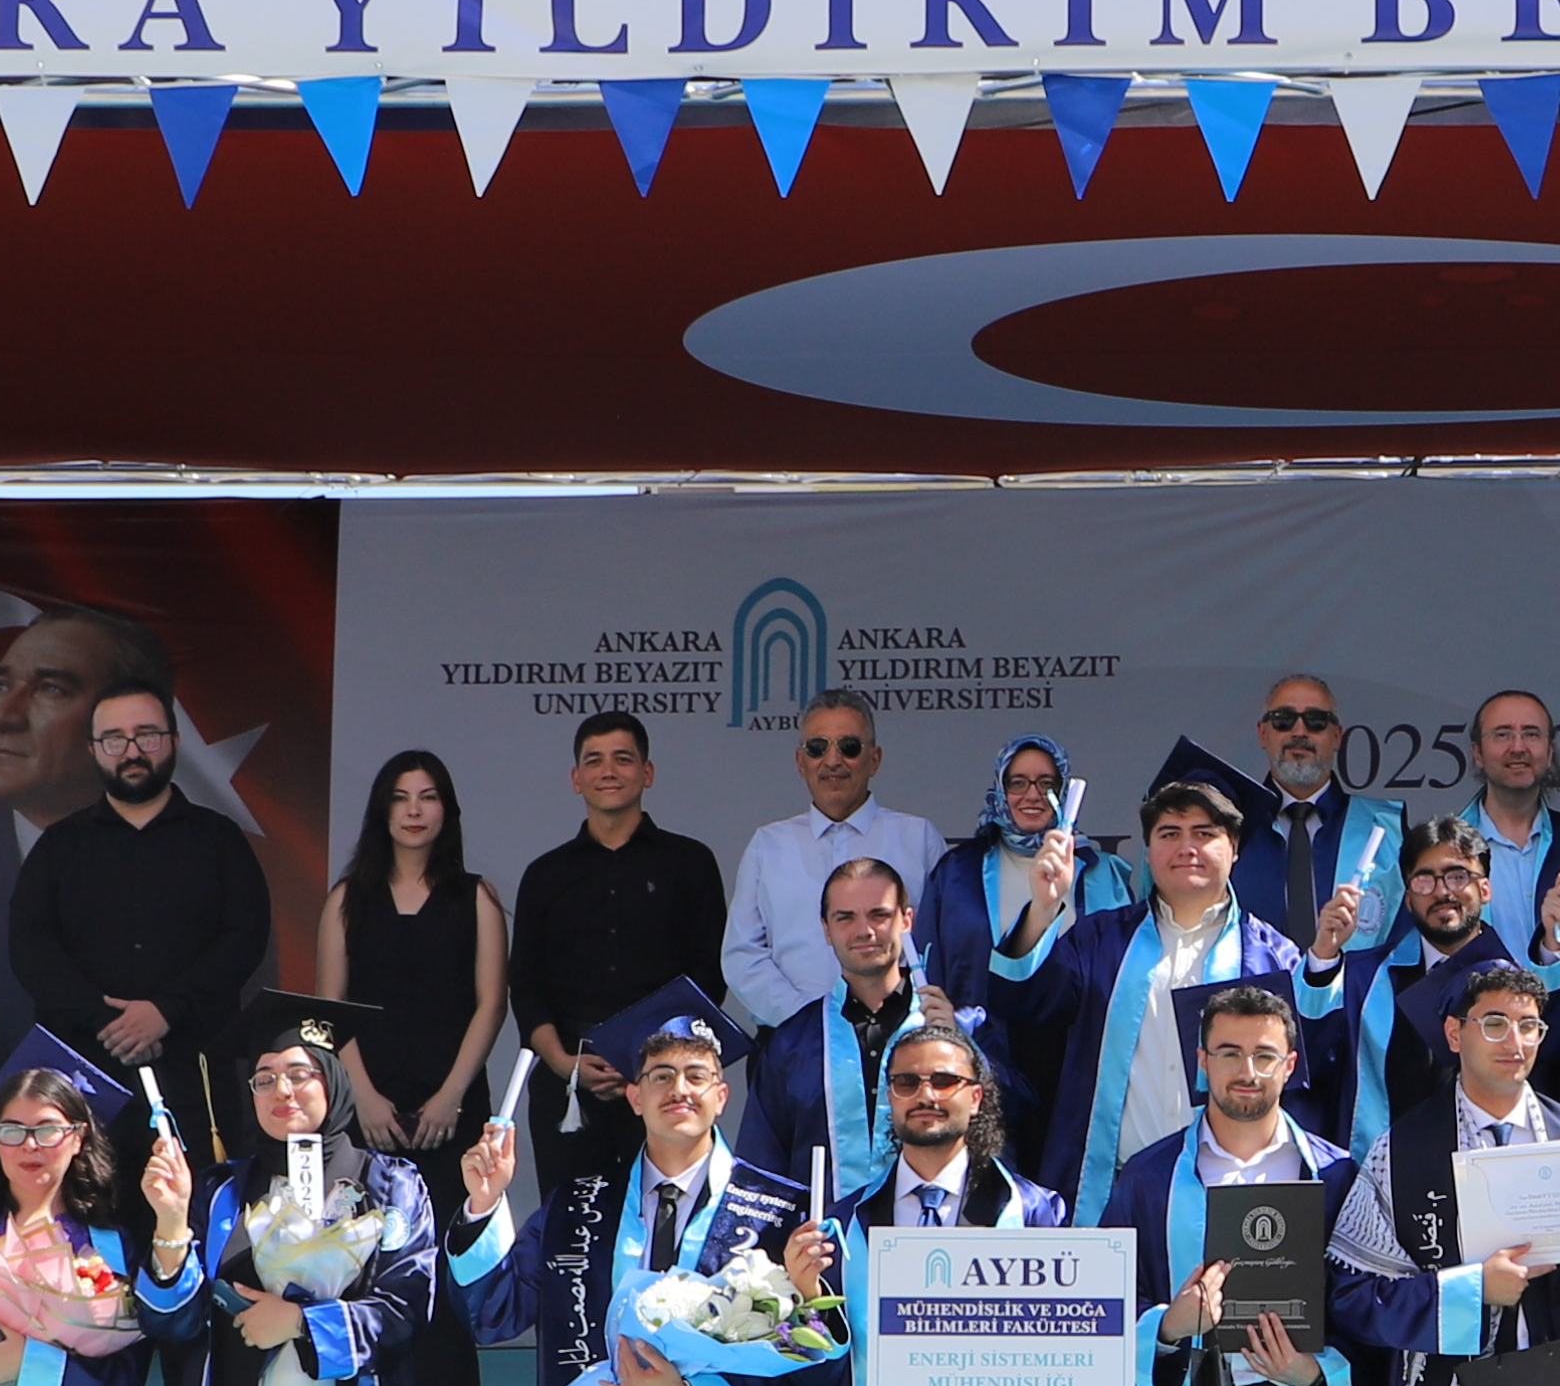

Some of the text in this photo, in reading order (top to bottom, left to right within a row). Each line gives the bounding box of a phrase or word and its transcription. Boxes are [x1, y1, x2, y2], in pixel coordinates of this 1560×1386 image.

[595, 631, 722, 652] ANKARA
[838, 628, 966, 649] ANKARA
[442, 662, 722, 684] YILDIRIM BEYAZIT
[838, 656, 1120, 680] YILDIRIM BEYAZIT
[533, 692, 722, 715] UNIVERSITY
[844, 682, 1053, 711] NİVERSİTESİ
[1337, 725, 1466, 789] 025
[726, 1183, 796, 1211] Energy systems
[727, 1202, 783, 1227] engineering
[961, 1251, 1080, 1287] AYBÜ
[897, 1300, 1106, 1317] MÜHENDİSLİK VE DOĞA
[905, 1317, 1098, 1333] BİLİMLERİ FAKÜLTESİ
[908, 1349, 1094, 1371] ENERJİ SİSTEMLERİ
